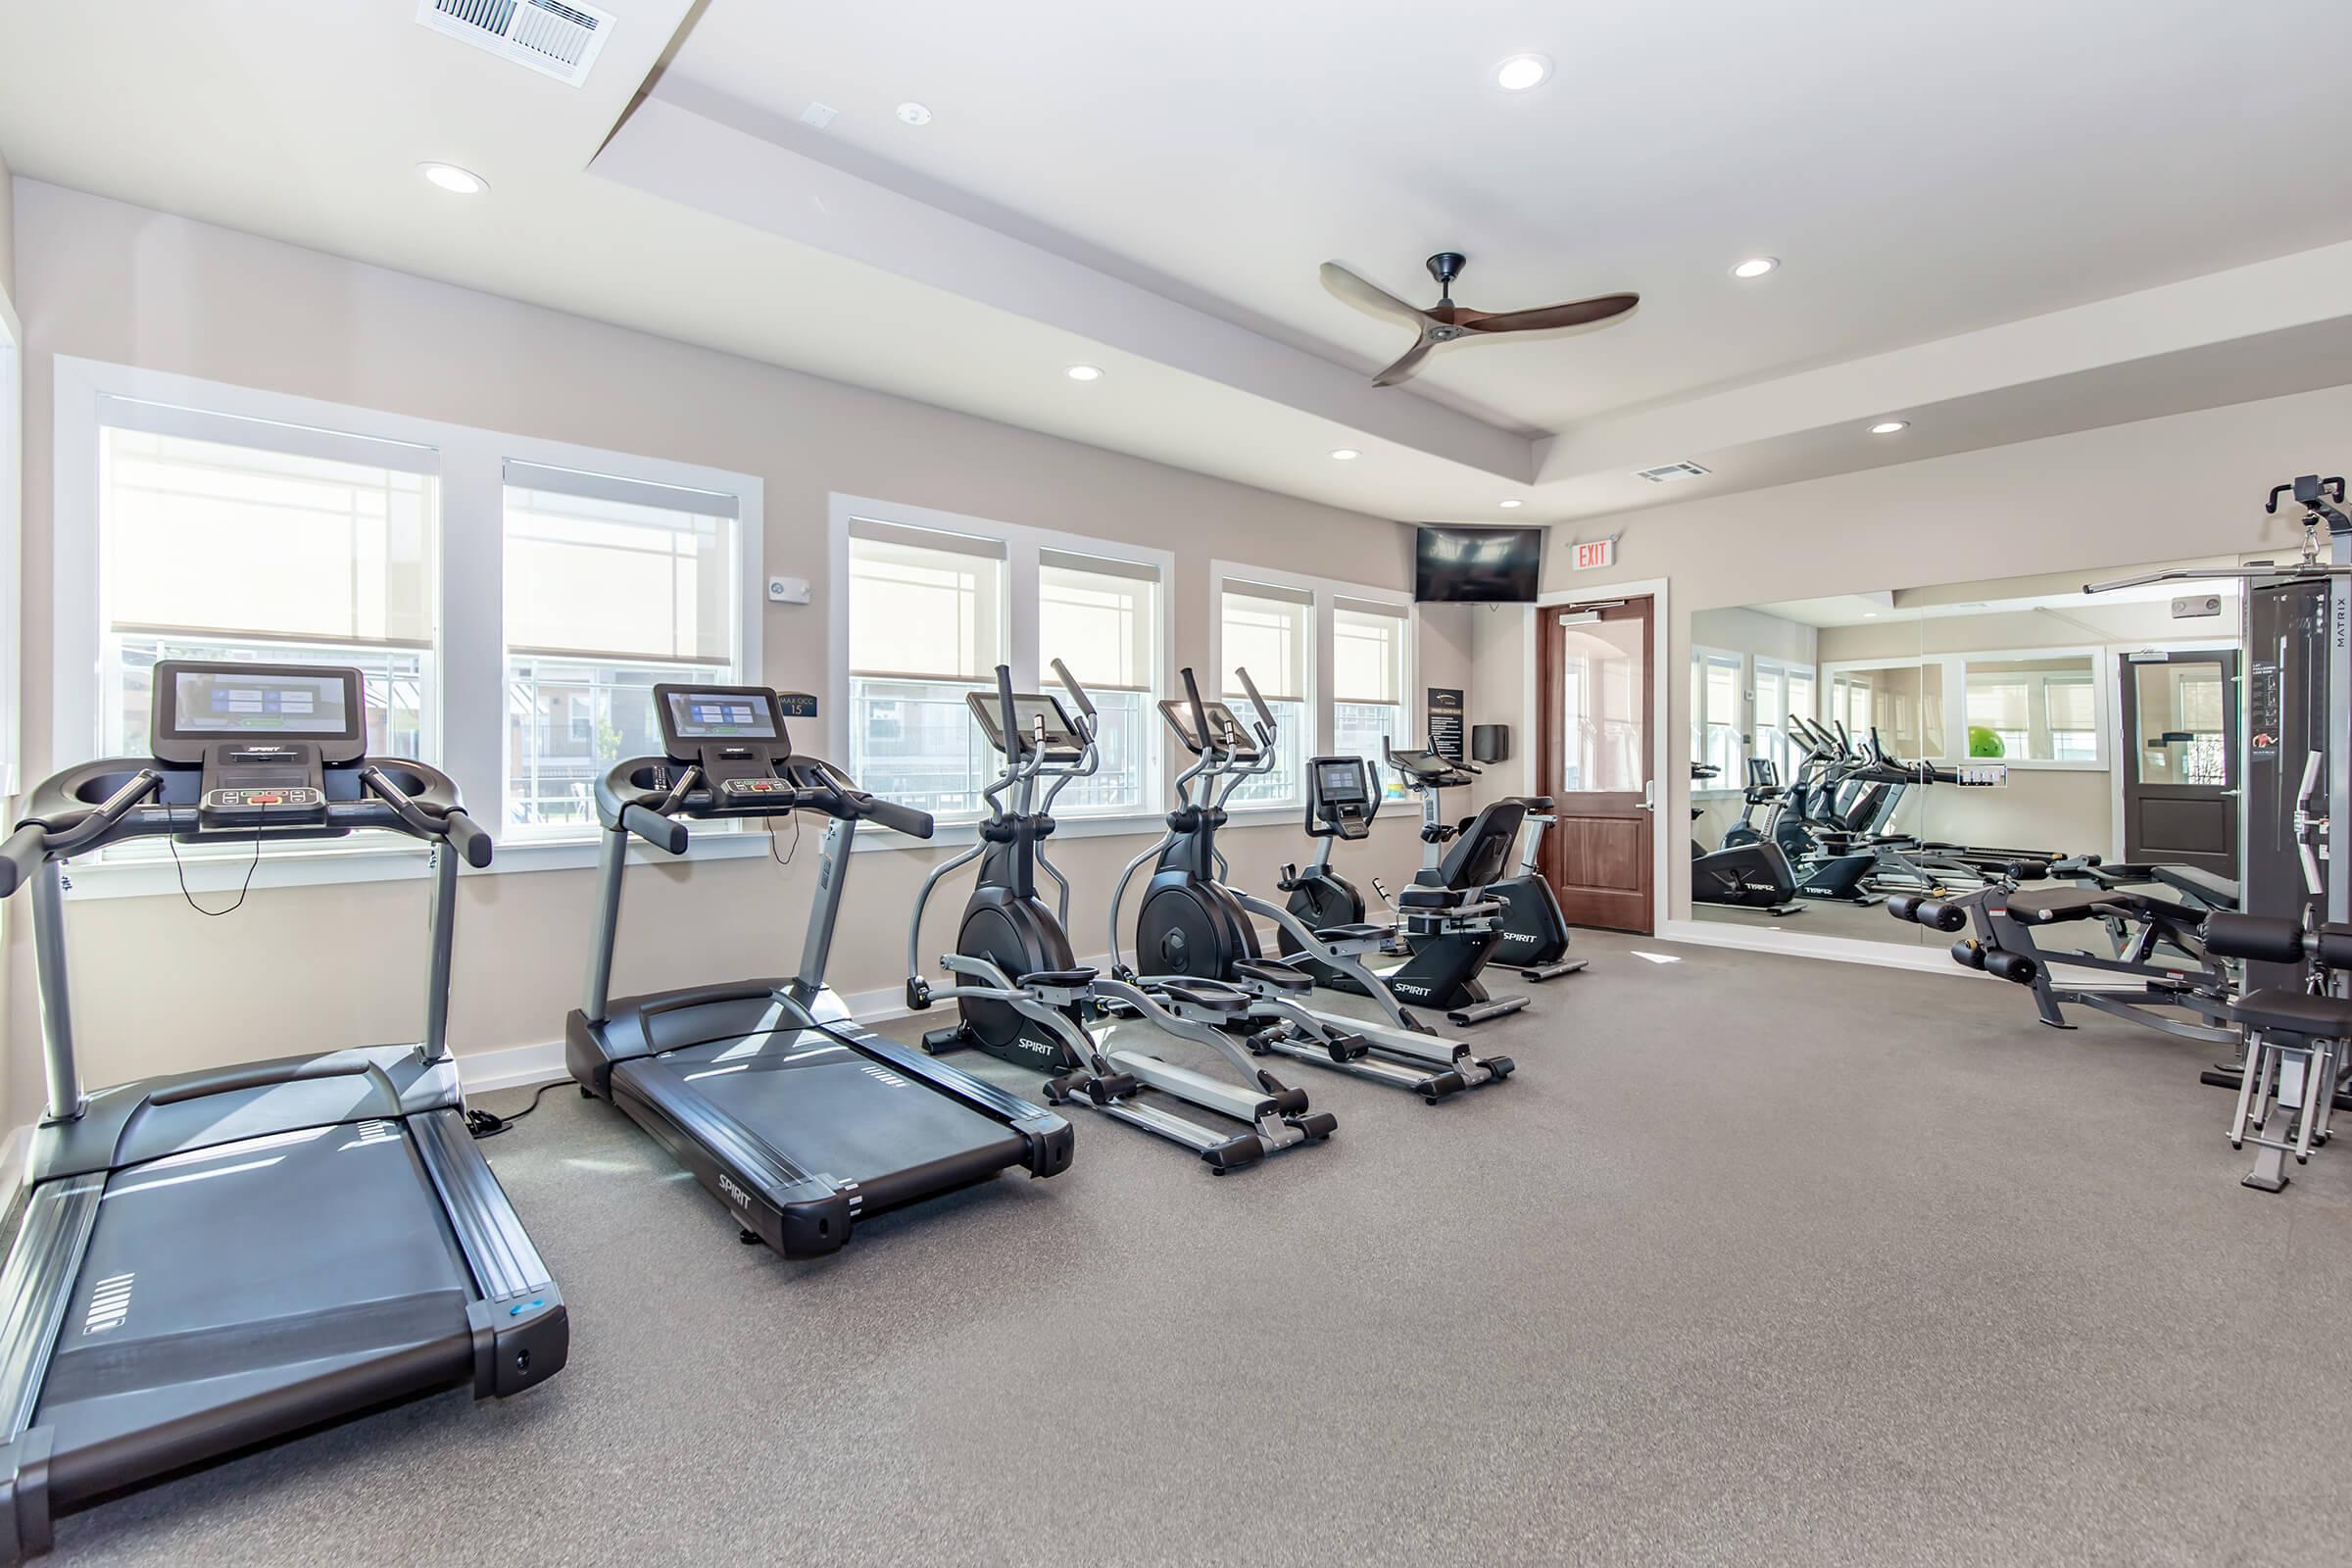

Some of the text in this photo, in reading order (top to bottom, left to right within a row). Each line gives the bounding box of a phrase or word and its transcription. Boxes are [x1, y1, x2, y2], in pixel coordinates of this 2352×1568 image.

[1579, 542, 1606, 567] EXIT
[792, 705, 802, 714] 15
[1503, 932, 1538, 943] SPIRIT
[1395, 983, 1432, 997] SPIRIT
[1018, 1038, 1054, 1055] SPIRIT
[718, 1173, 752, 1210] SPIRIT
